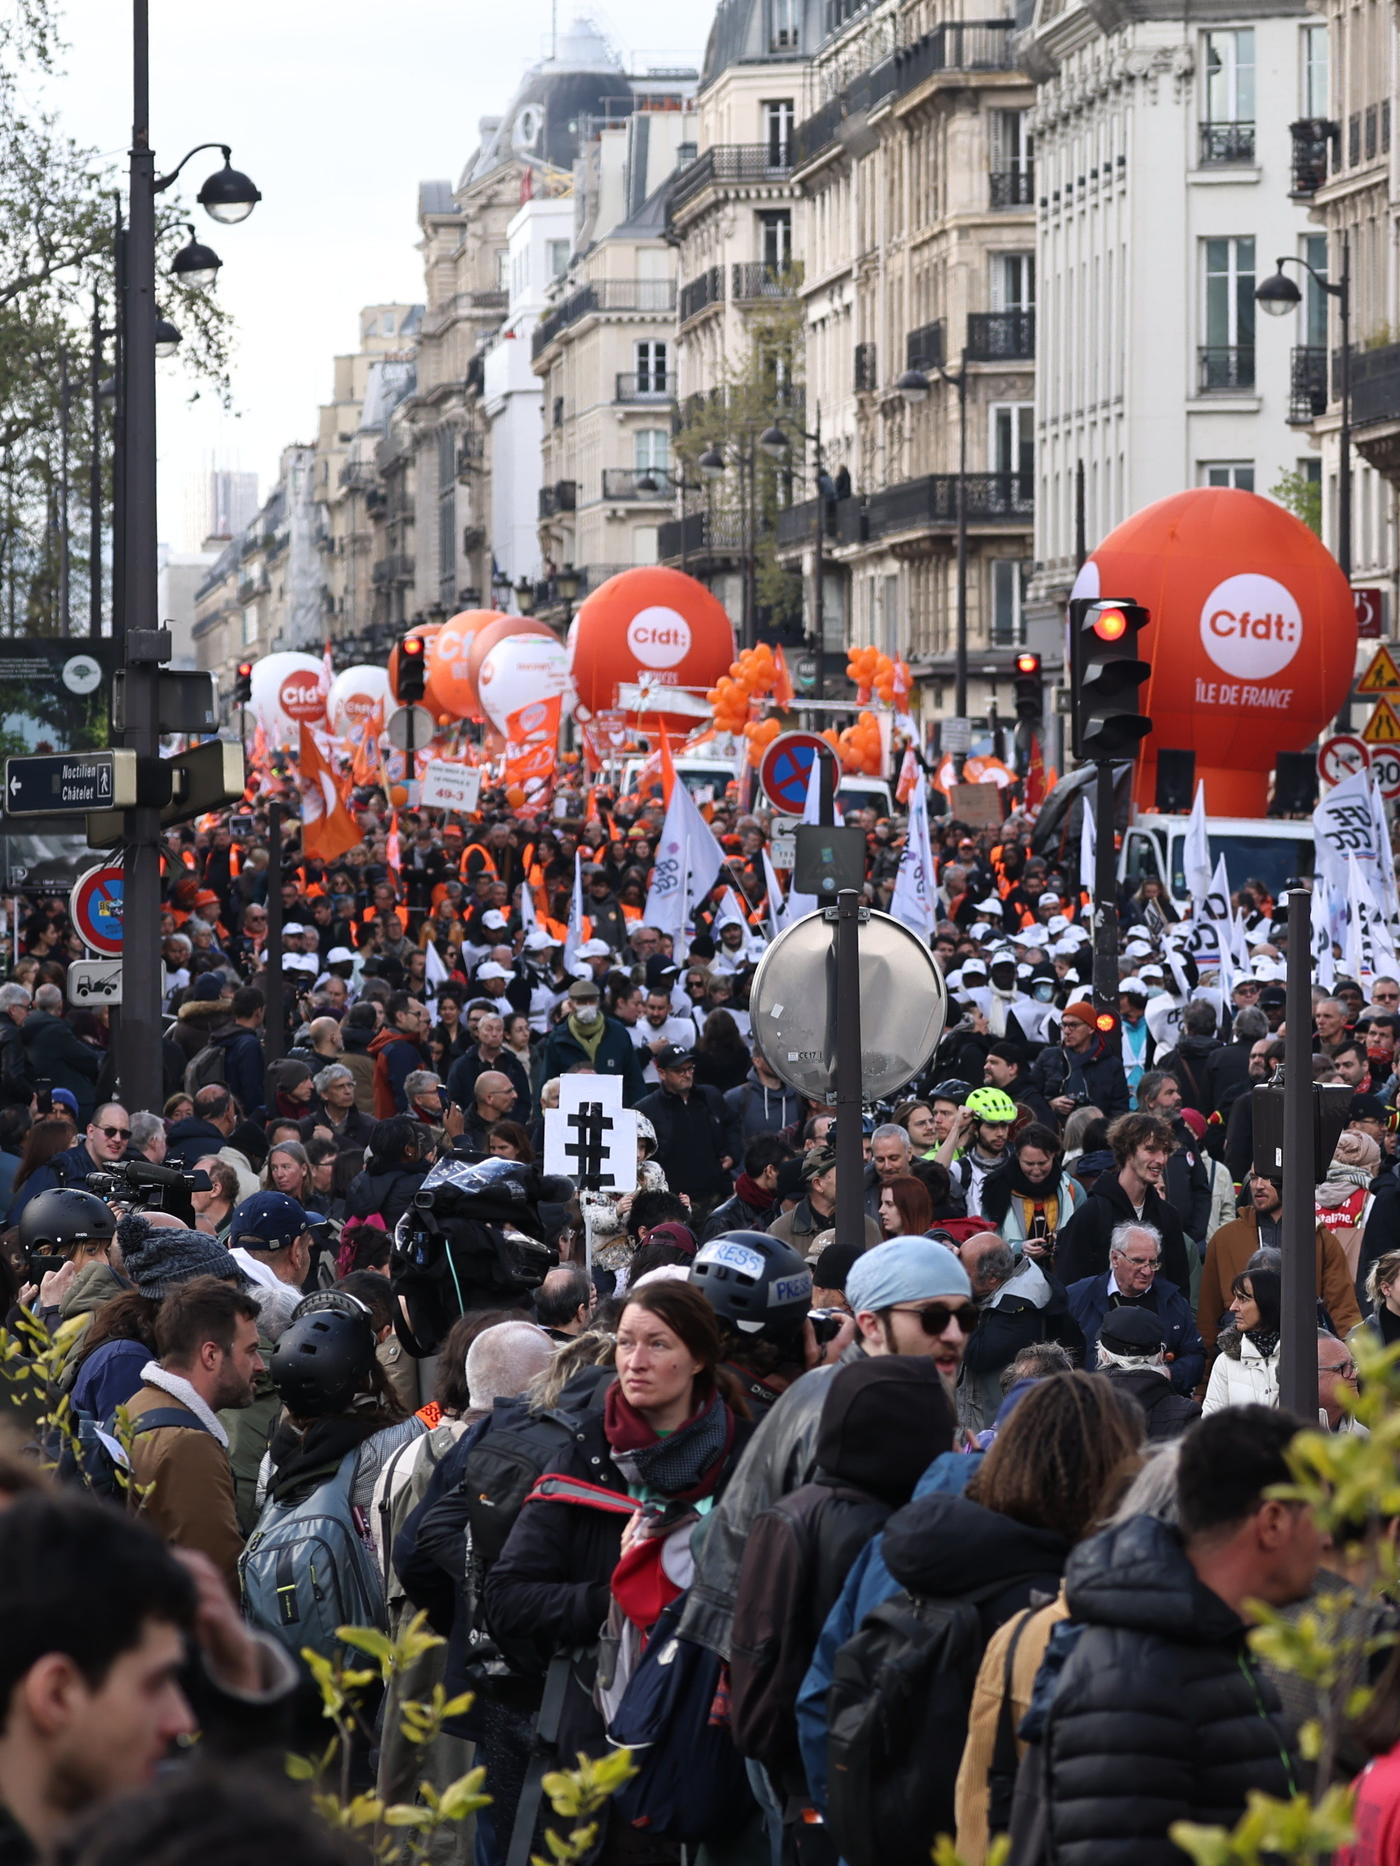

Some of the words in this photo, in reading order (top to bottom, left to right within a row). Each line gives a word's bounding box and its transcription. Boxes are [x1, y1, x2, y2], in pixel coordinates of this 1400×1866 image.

[1209, 610, 1295, 642] Cfdt:
[282, 686, 322, 704] Cfd
[1195, 677, 1217, 703] ÎLE
[1220, 685, 1240, 705] DE
[1240, 686, 1293, 709] FRANCE
[62, 764, 96, 779] Noctilien
[1372, 761, 1400, 784] 30
[62, 787, 94, 801] Châtelet
